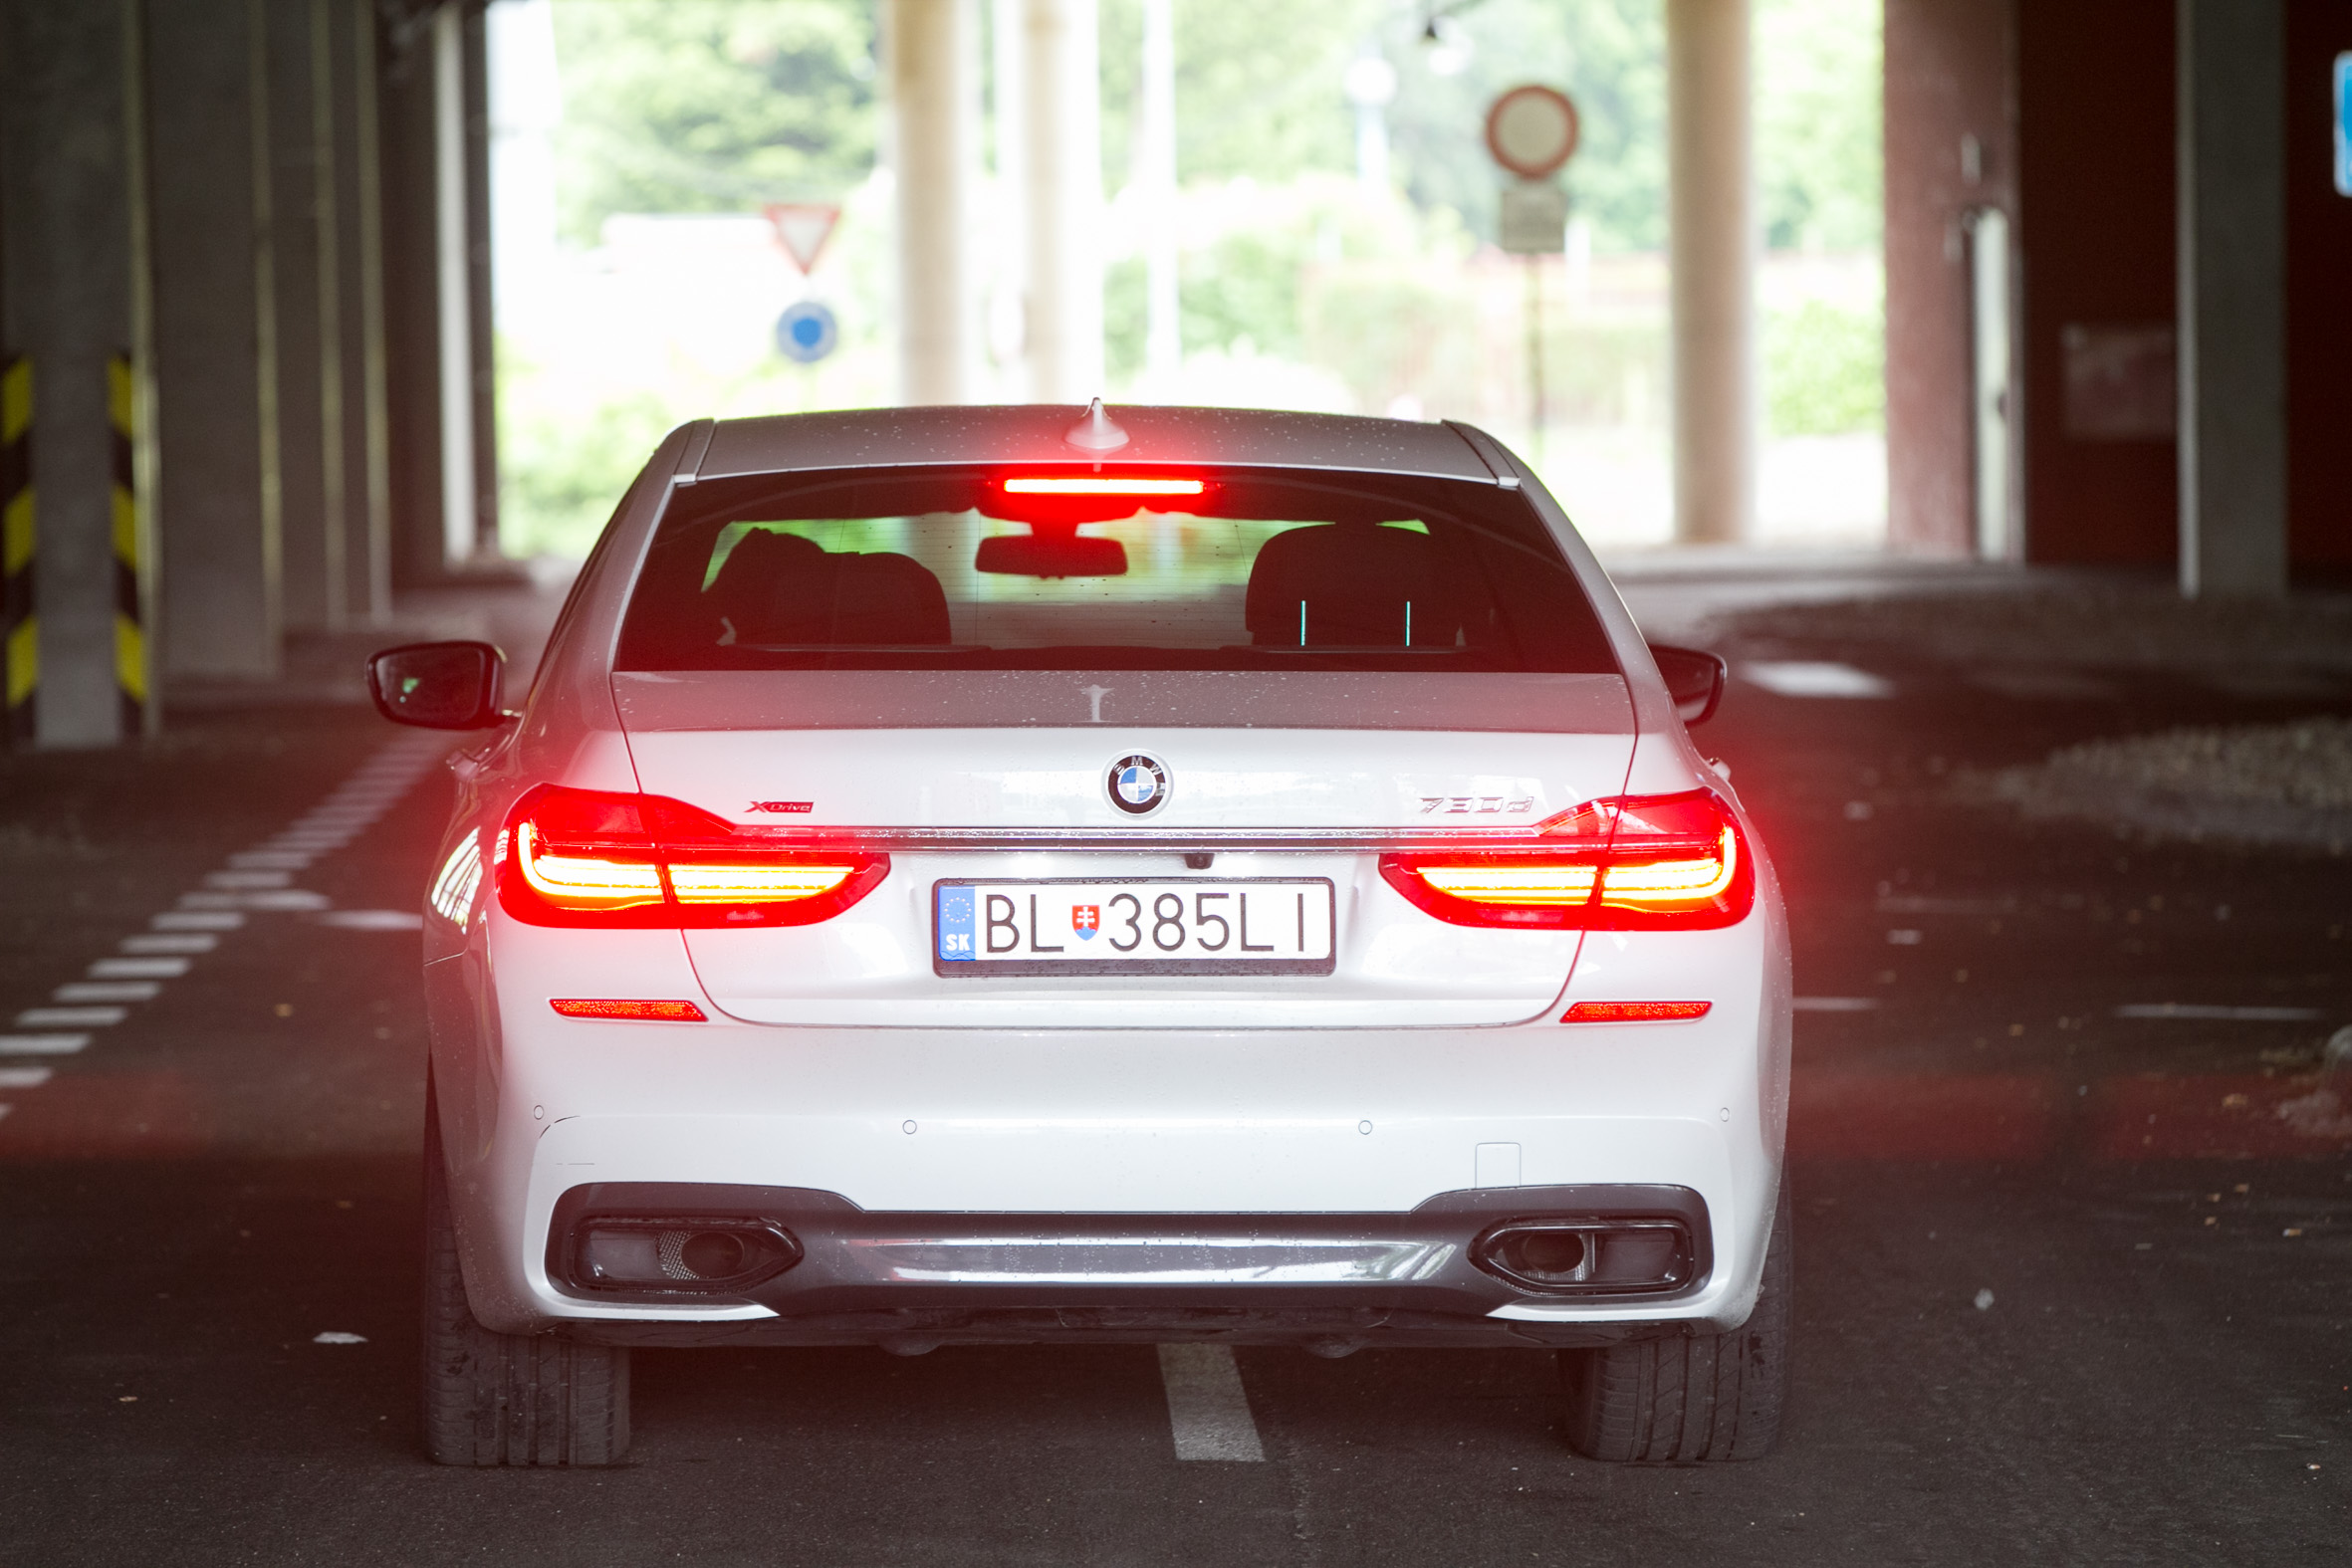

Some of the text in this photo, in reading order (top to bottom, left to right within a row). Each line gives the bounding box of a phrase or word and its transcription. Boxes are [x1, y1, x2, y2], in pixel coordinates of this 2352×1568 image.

[1113, 756, 1163, 776] BMW
[1418, 796, 1533, 813] 730d
[986, 893, 1304, 953] BL 385LI
[946, 934, 970, 951] SK
